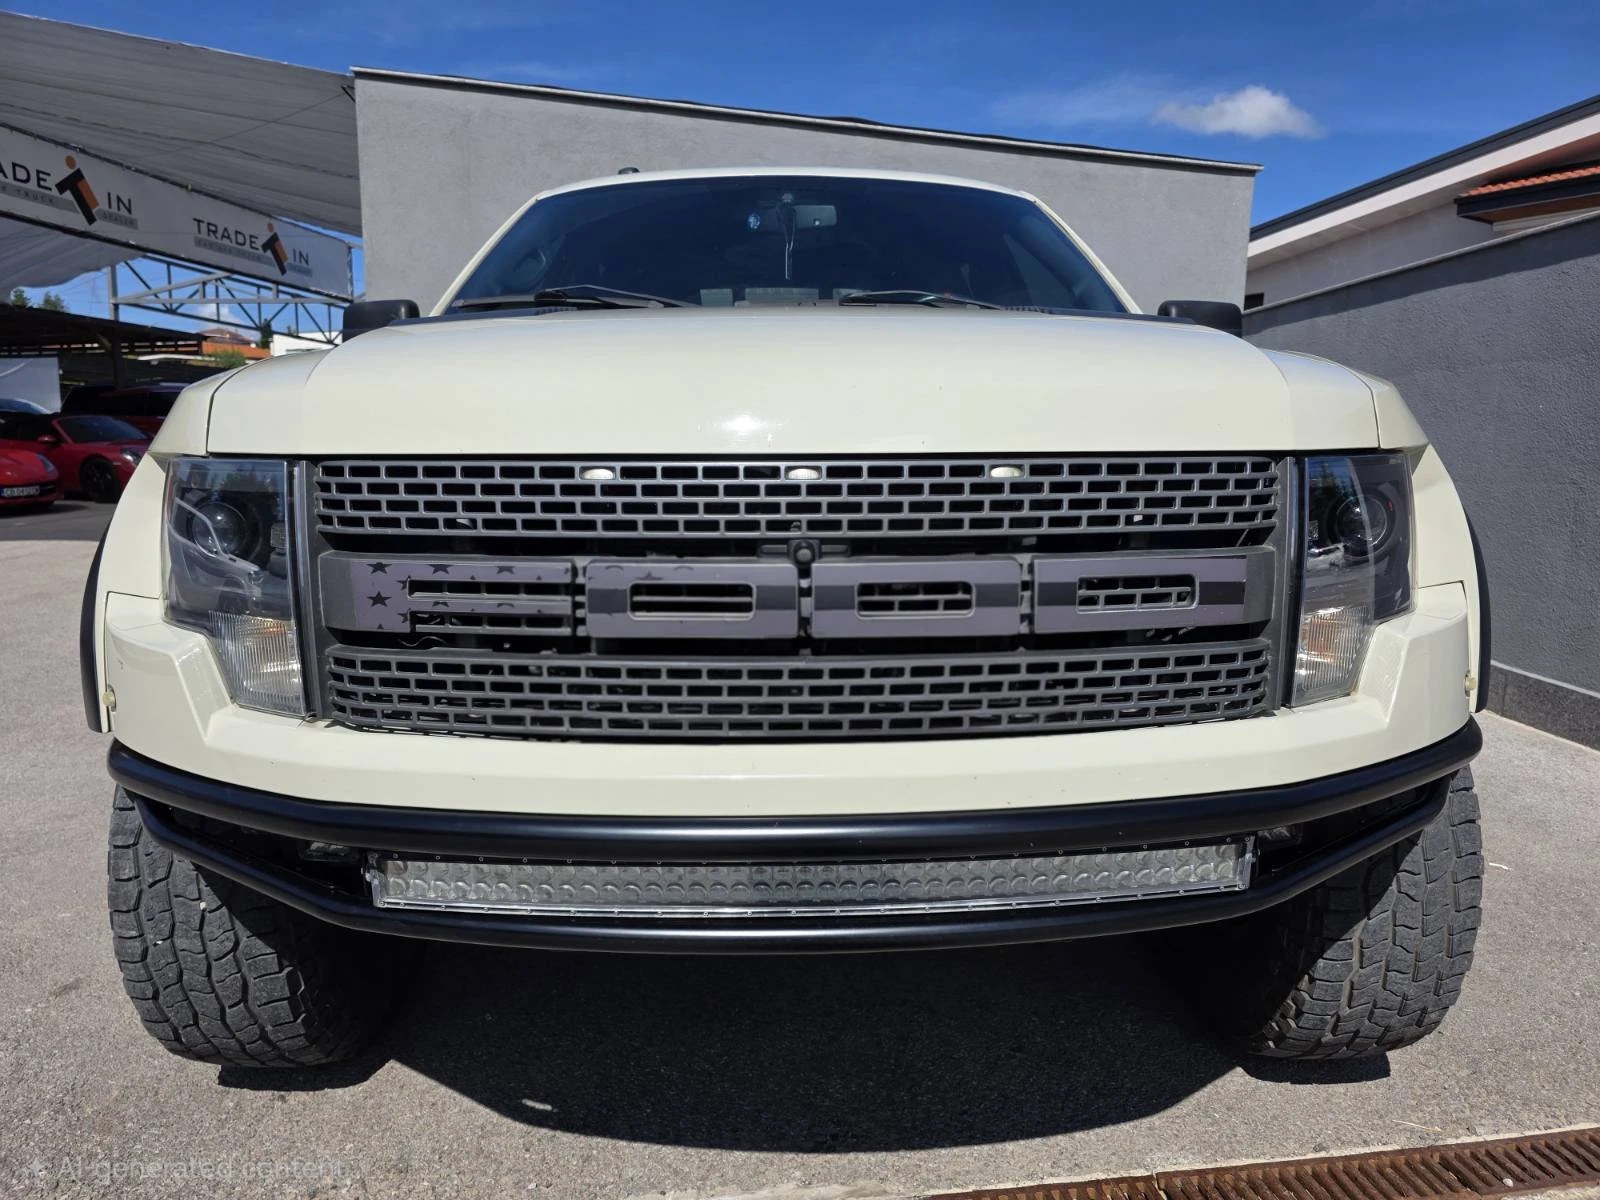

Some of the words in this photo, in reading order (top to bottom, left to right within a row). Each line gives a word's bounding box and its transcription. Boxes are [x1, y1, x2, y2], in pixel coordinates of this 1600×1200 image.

[107, 191, 132, 215] IN
[192, 217, 260, 251] TRADE
[293, 248, 310, 266] IN
